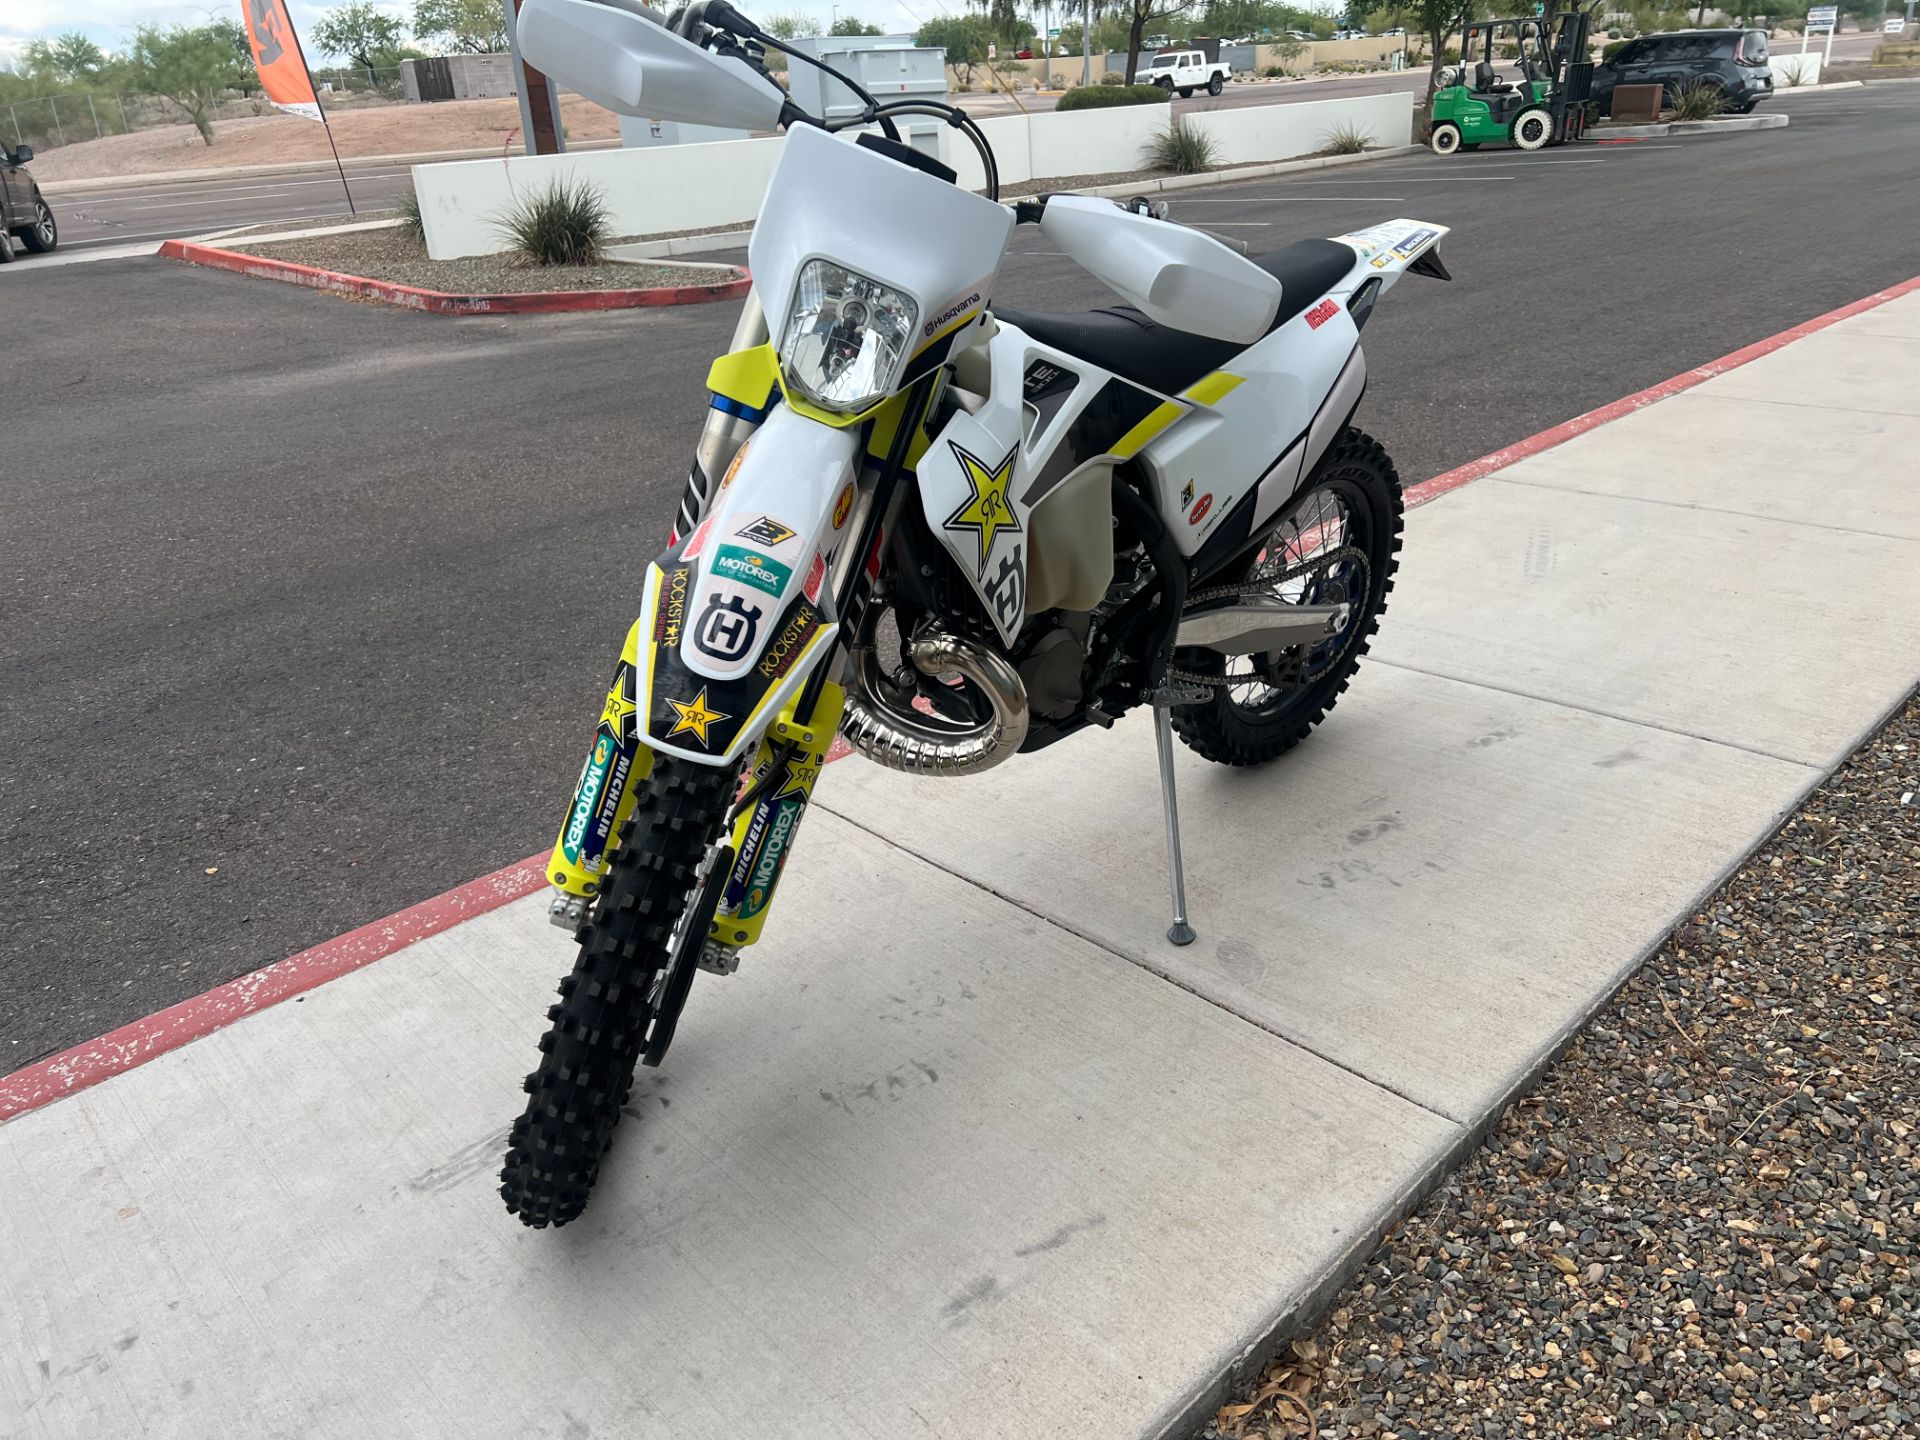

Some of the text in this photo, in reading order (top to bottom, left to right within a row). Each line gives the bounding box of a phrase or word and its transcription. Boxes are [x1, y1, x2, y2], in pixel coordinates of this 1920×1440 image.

[934, 293, 980, 328] Husqvarna
[719, 557, 779, 586] MOTOREX
[565, 765, 603, 853] MOTOREX
[597, 755, 630, 838] MICHELIN
[734, 803, 770, 883] MICHELIN
[753, 805, 796, 887] MOTOREX
